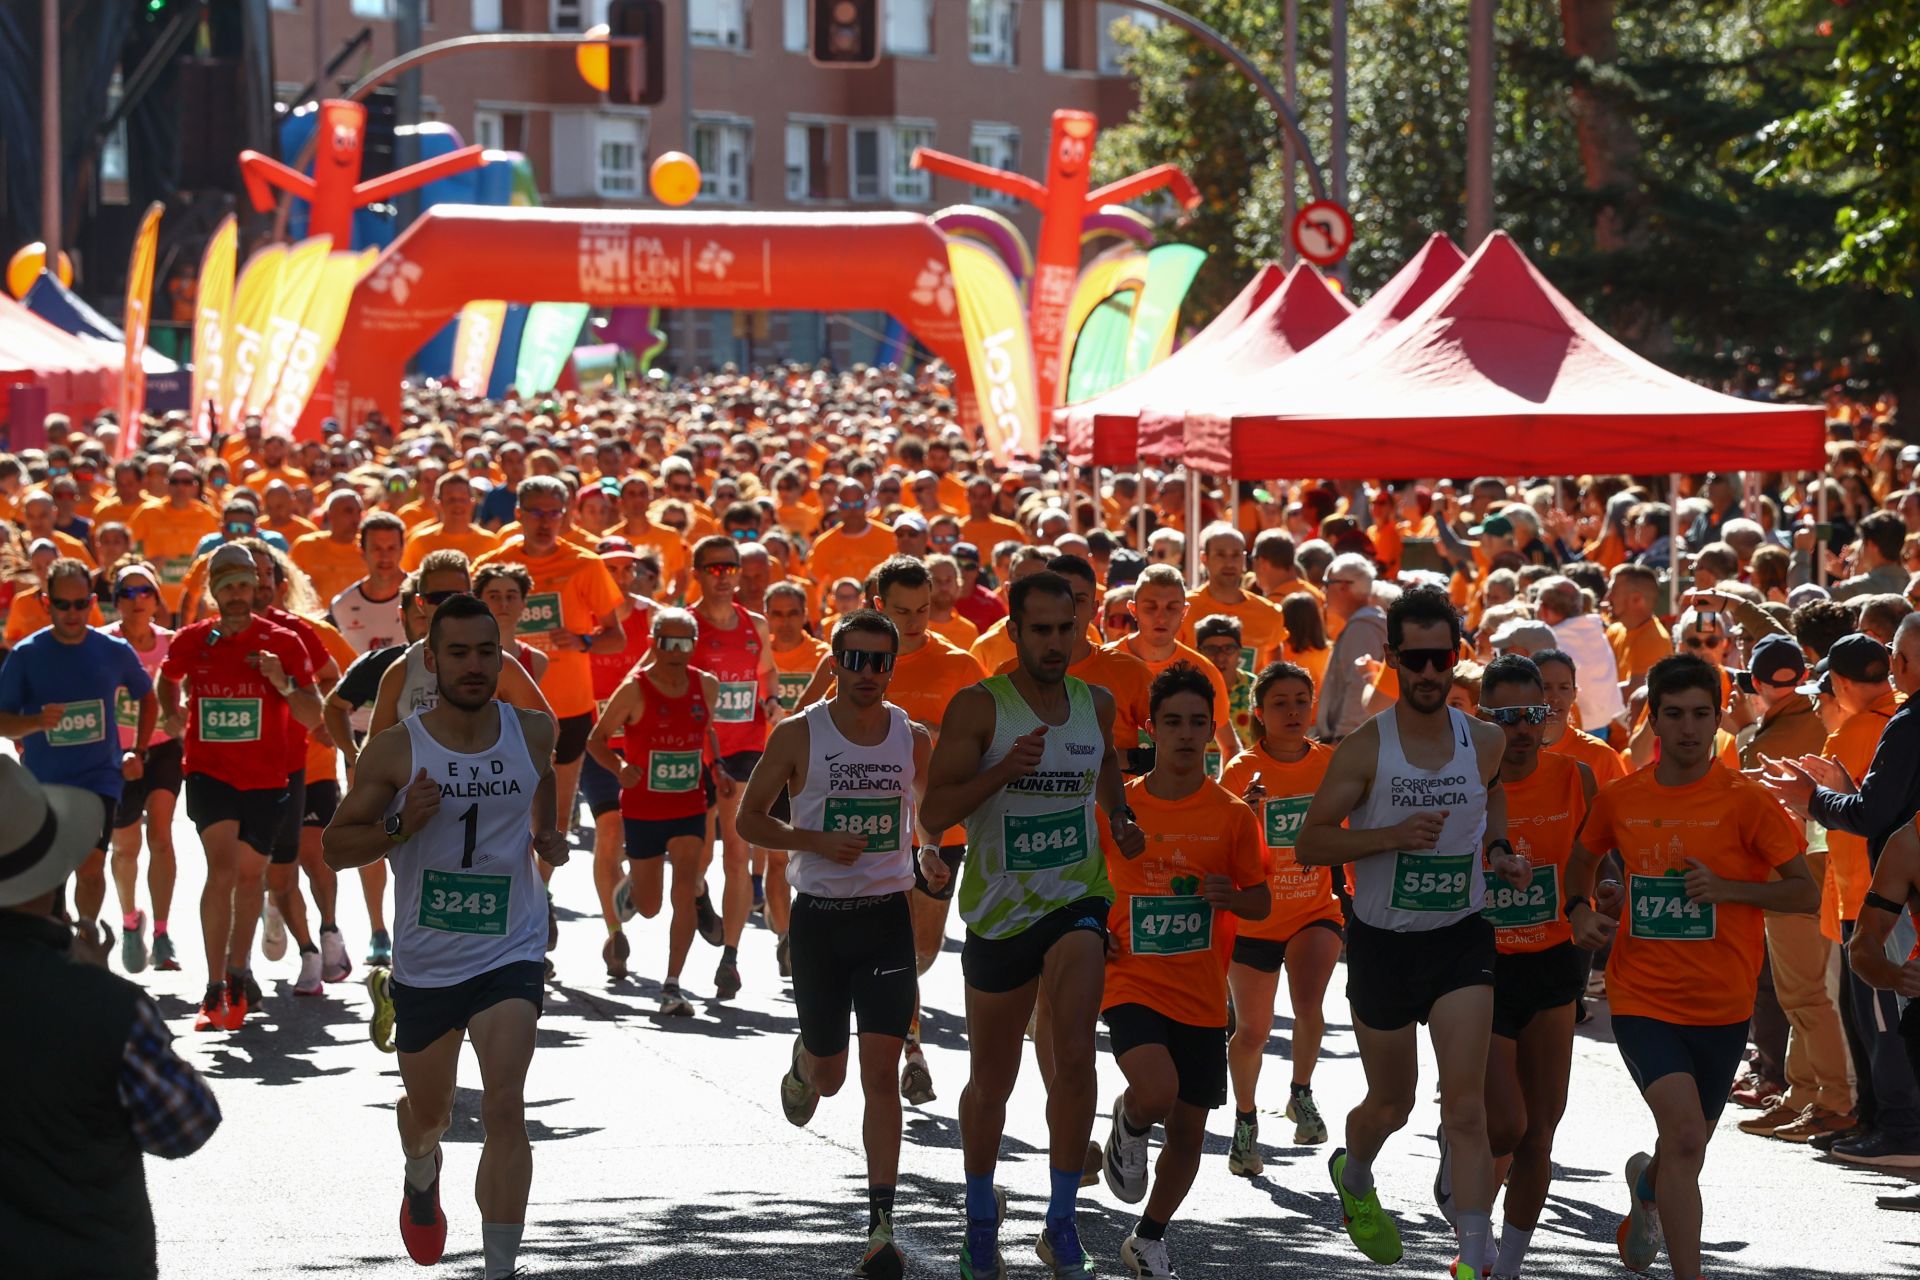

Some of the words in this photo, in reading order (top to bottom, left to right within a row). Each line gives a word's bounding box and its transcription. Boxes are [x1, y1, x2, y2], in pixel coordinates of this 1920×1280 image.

[517, 605, 552, 622] 886
[207, 711, 251, 727] 6128
[448, 762, 459, 777] E
[470, 766, 480, 780] y
[490, 760, 504, 775] D
[656, 763, 696, 779] 6124
[829, 763, 903, 776] CORRIENDO
[830, 779, 902, 791] PALENCIA
[1391, 775, 1467, 791] CORRIENDO
[1391, 792, 1468, 807] PALENCIA
[832, 814, 893, 835] 3849
[1275, 811, 1308, 832] 37
[459, 803, 479, 869] 1
[1014, 826, 1078, 853] 4842
[1403, 872, 1467, 893] 5529
[431, 889, 497, 915] 3243
[809, 899, 855, 911] NIKE
[1484, 885, 1546, 909] 4862
[1636, 896, 1701, 919] 4744
[1141, 913, 1202, 936] 4750
